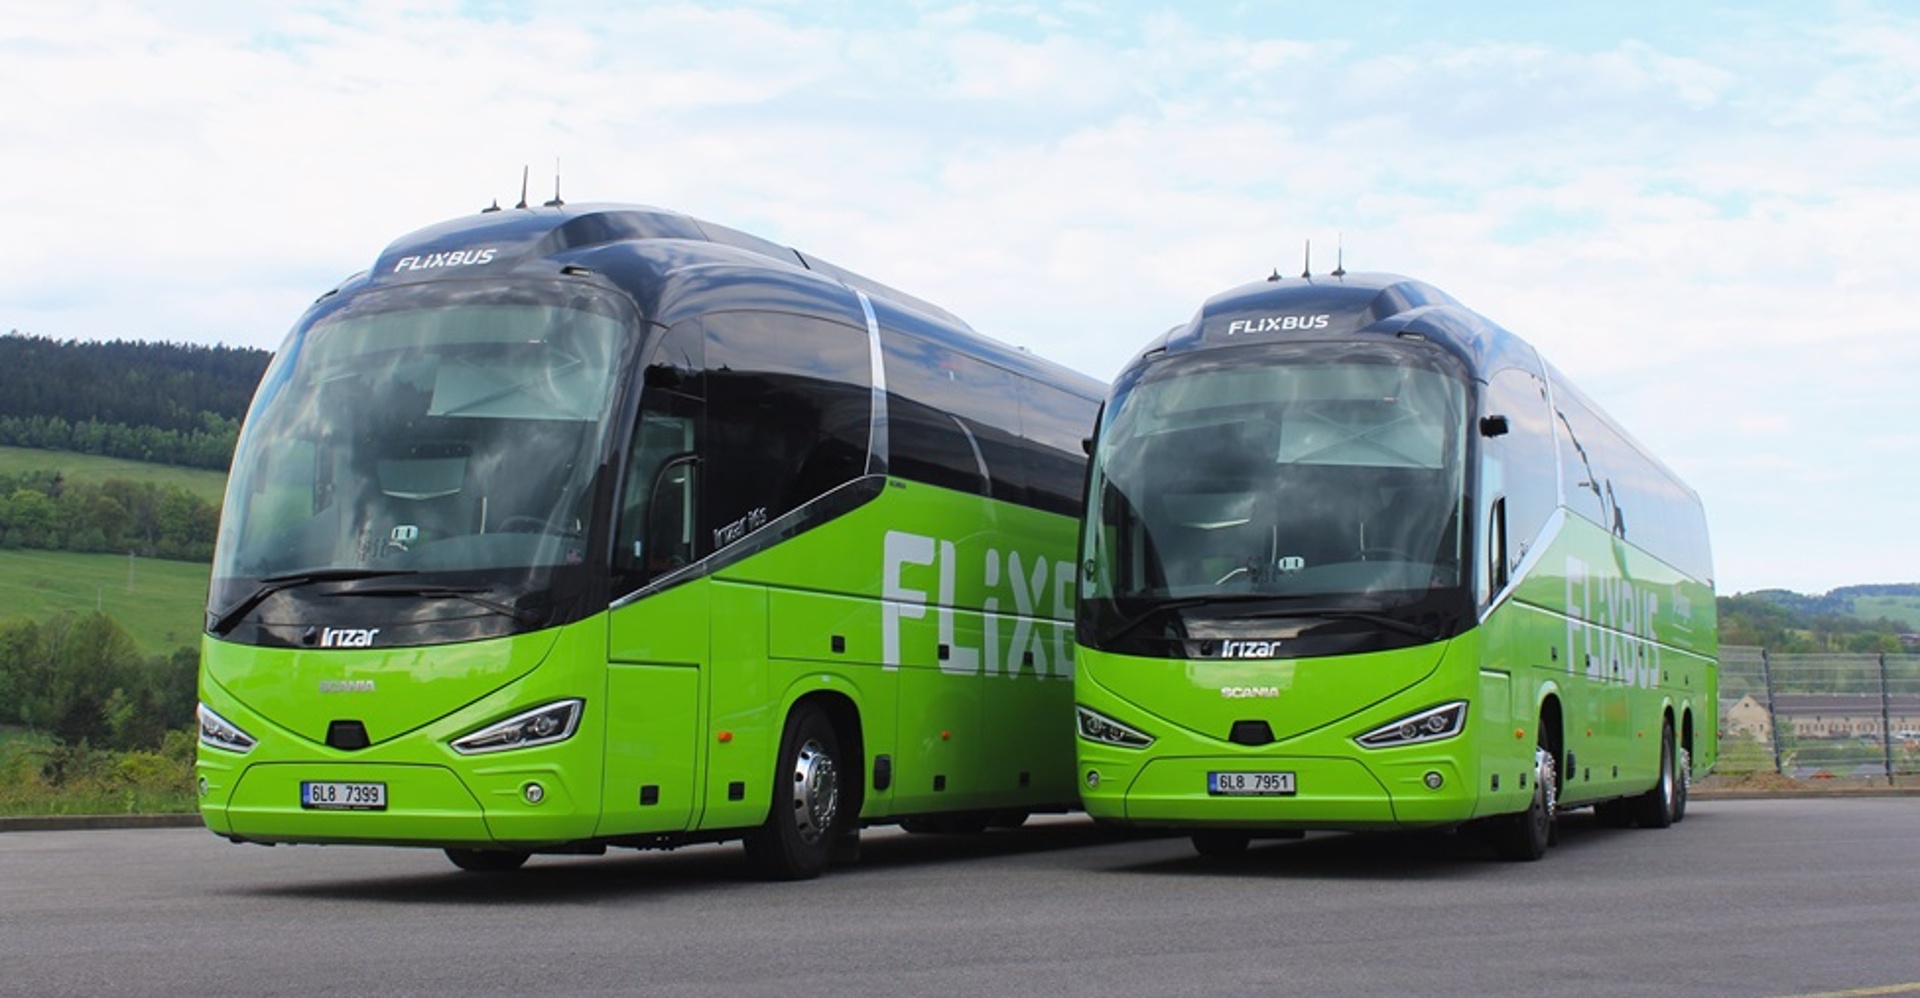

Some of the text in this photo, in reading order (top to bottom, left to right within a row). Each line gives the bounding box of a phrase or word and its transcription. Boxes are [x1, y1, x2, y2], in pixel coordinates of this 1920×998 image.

[320, 626, 380, 648] Irizar
[1221, 639, 1282, 659] Irizar
[1220, 686, 1280, 698] SCANIA
[1220, 774, 1288, 790] 6L8 7951
[312, 784, 379, 803] 6L8 7399
